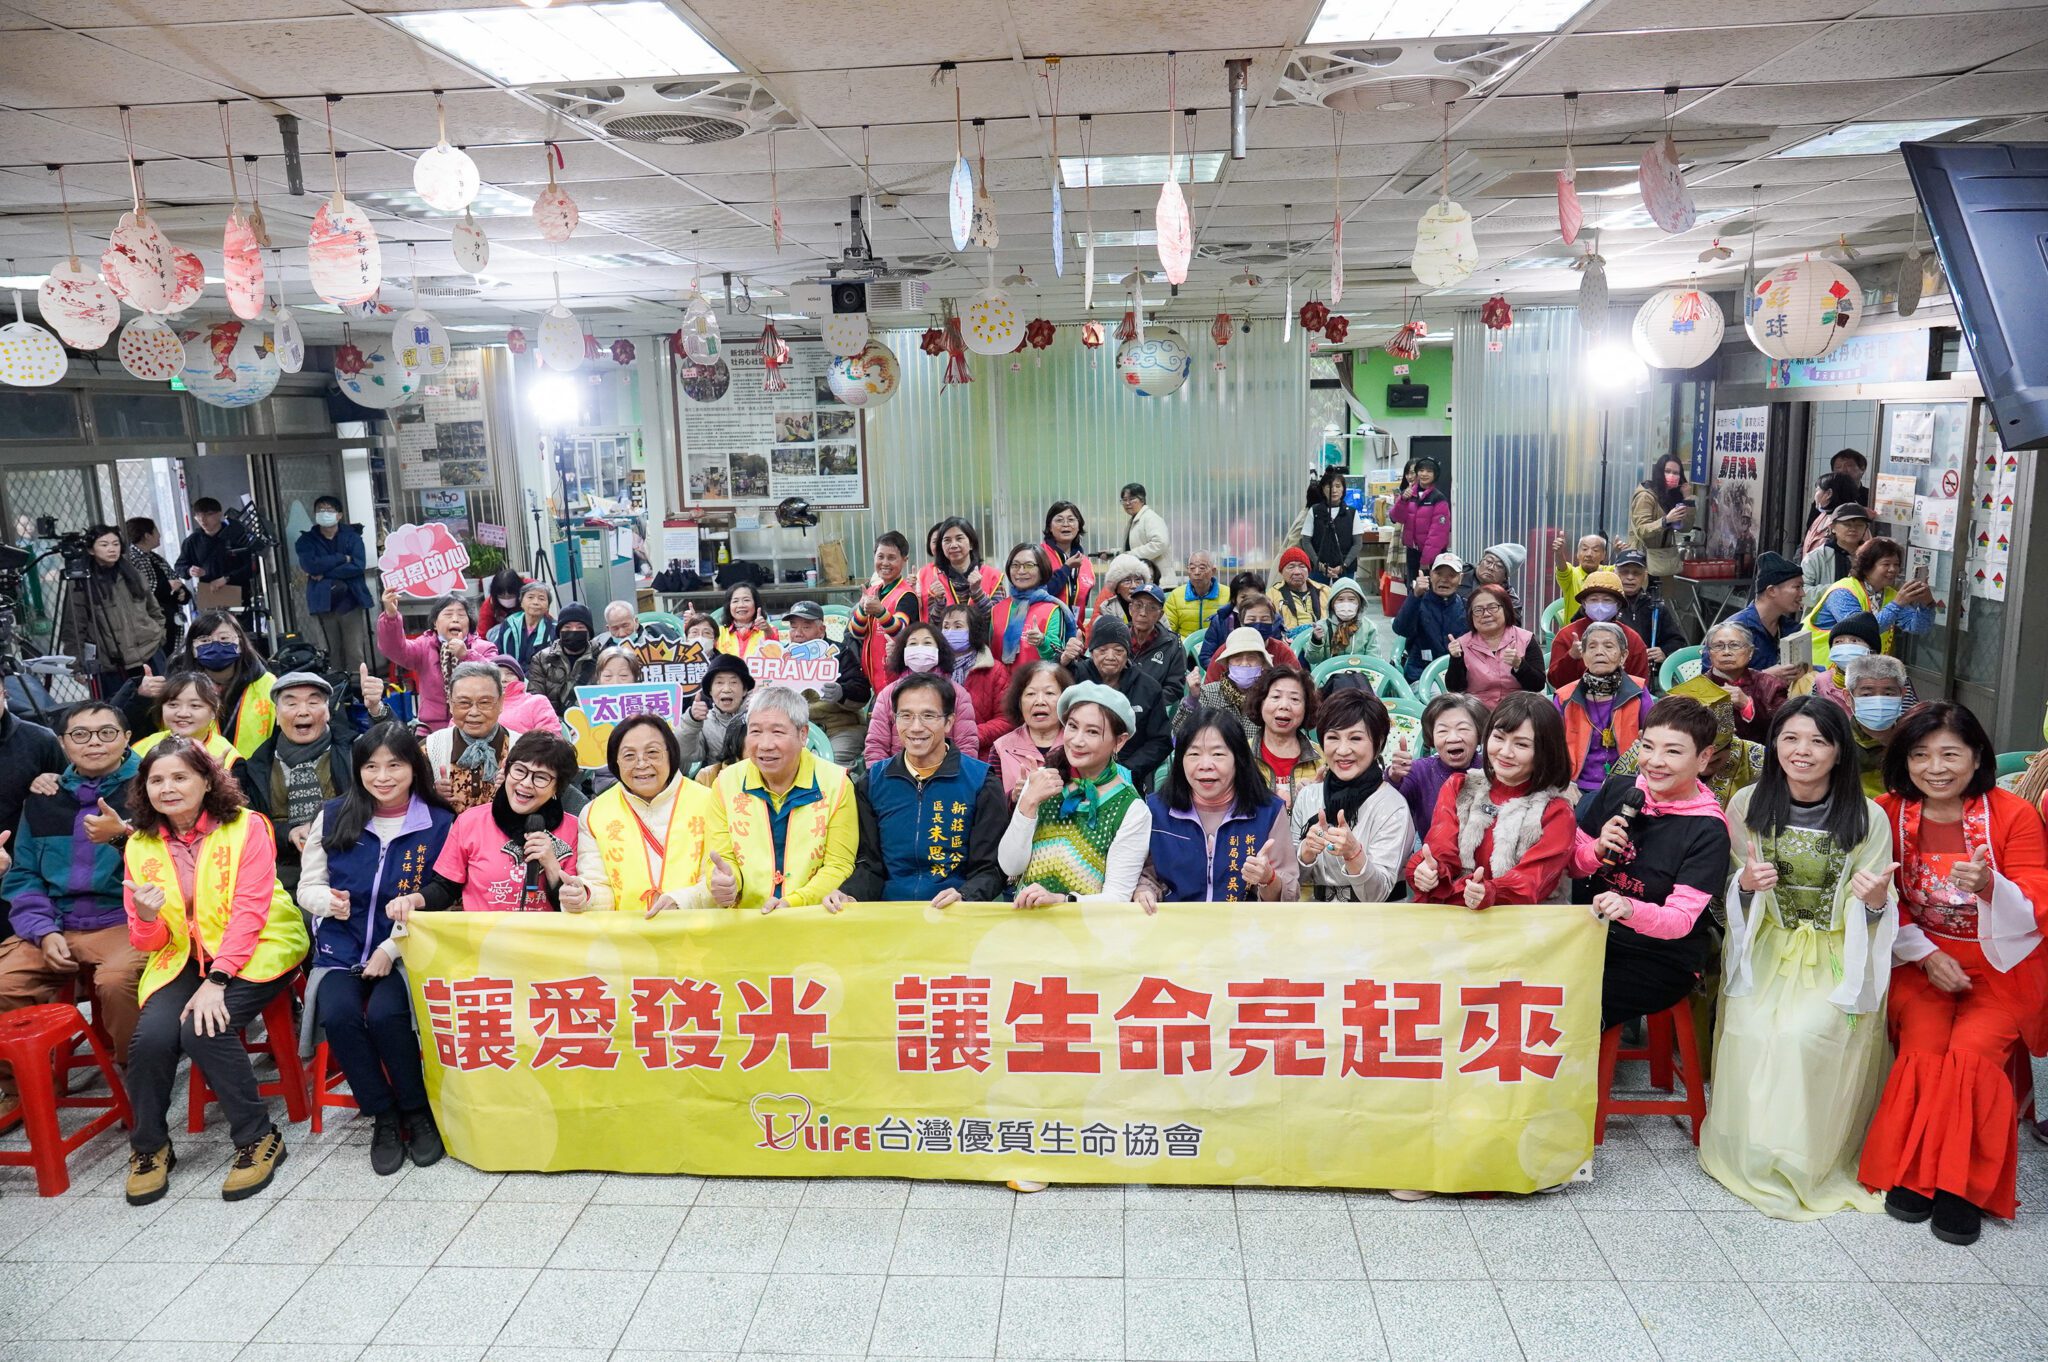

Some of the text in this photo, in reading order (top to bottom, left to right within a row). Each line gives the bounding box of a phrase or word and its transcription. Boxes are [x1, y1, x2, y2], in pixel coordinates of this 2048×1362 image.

[1765, 267, 1798, 338] 五彩球
[1716, 432, 1765, 452] 大規模震災救災
[384, 543, 468, 592] 感恩的心
[641, 662, 709, 685] 場最讚
[749, 657, 838, 682] BRAVO
[254, 699, 270, 736] 牡丹
[592, 691, 672, 723] 太優秀
[423, 975, 1565, 1082] 讓愛發光 讓生命亮起來
[875, 1116, 1203, 1157] 台灣優質生命協會
